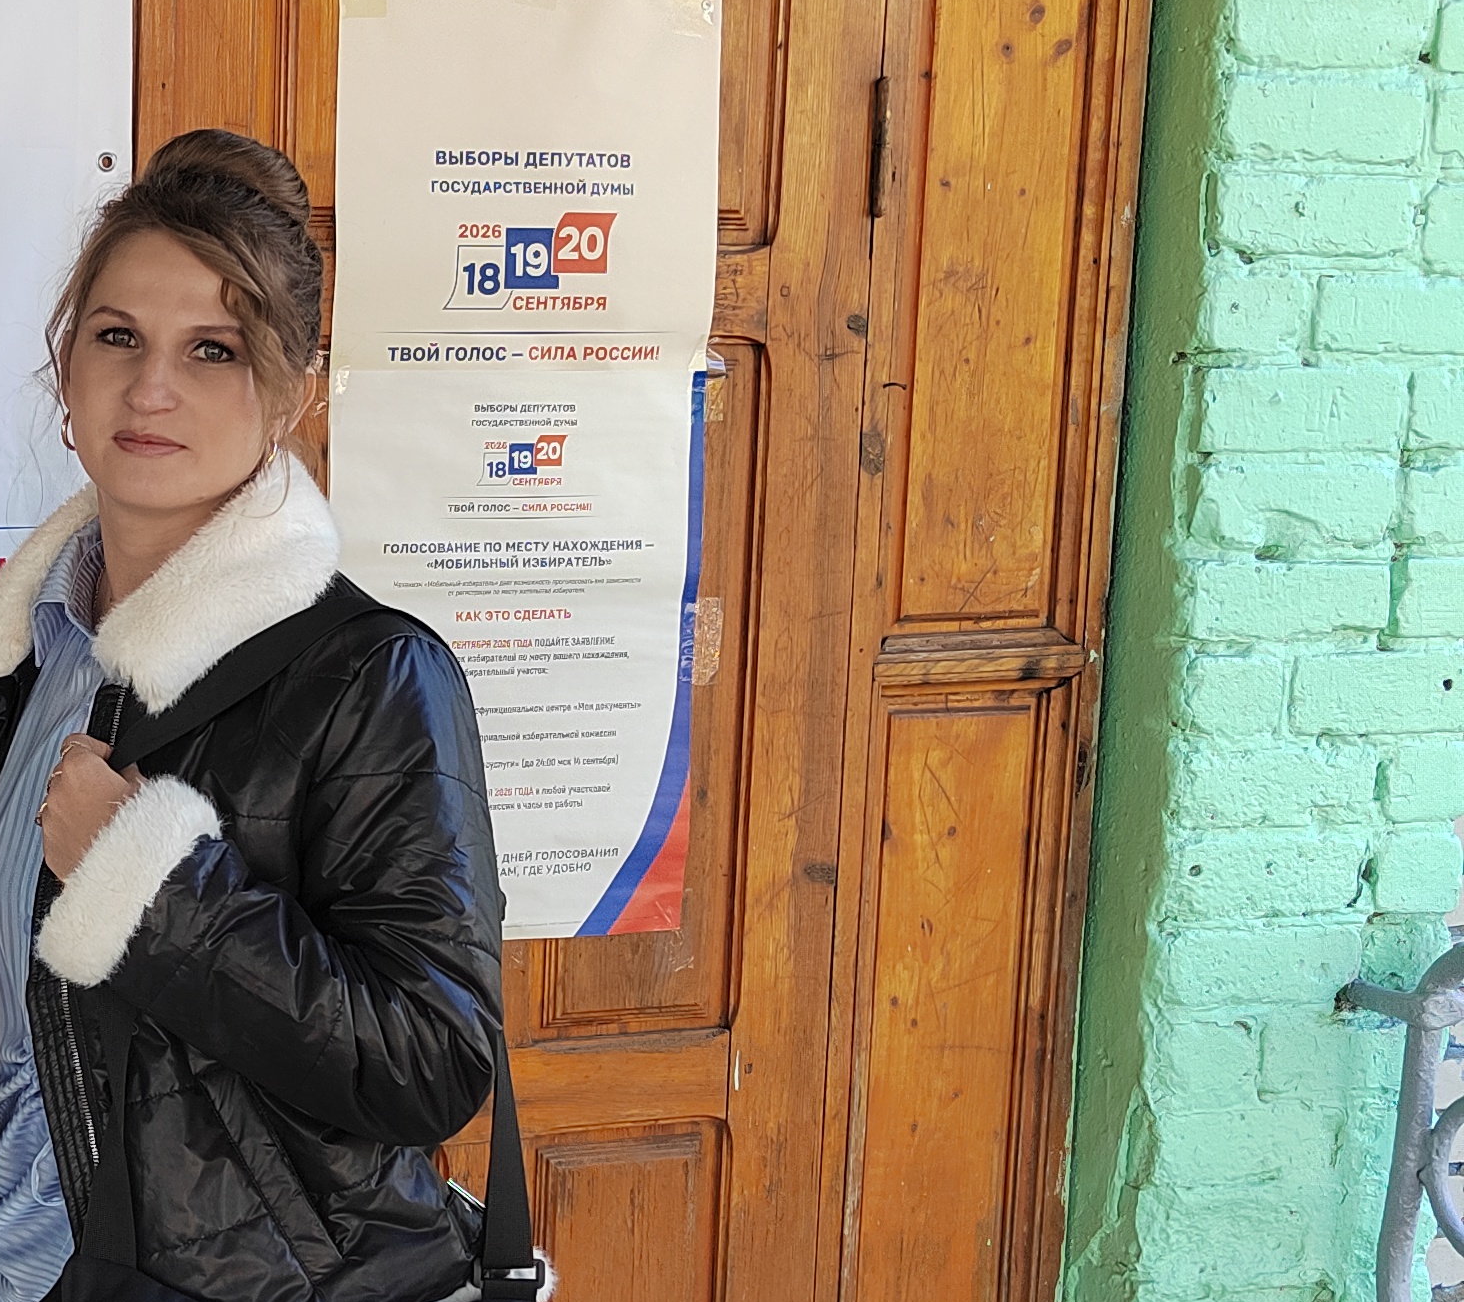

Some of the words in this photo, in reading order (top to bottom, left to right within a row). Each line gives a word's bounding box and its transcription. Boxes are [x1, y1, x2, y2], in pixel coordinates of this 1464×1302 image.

[435, 150, 519, 167] ВЫБОРЫ
[524, 152, 631, 169] ДЕПУТАТОВ
[431, 179, 586, 196] ГОСУДАРСТВЕННОЙ
[590, 182, 635, 198] ДУМЫ
[458, 224, 502, 239] 2026
[462, 262, 501, 296] 18
[510, 242, 549, 277] 19
[557, 226, 605, 261] 20
[512, 296, 607, 311] СЕНТЯБРЯ
[387, 342, 440, 362] ТВОЙ
[445, 346, 507, 362] ГОЛОС
[528, 345, 577, 362] СИЛА
[582, 345, 660, 362] РОССИИ!
[474, 403, 518, 413] ВЫБОРЫ
[520, 403, 576, 414] ДЕПУТАТОВ
[471, 417, 551, 428] ГОСУДАРСТВЕННОЙ
[553, 419, 578, 428] ДУМЫ
[486, 461, 506, 479] 18
[511, 450, 532, 469] 19
[536, 441, 561, 460] 20
[512, 477, 562, 486] СЕНТЯБРЯ
[448, 501, 475, 513] ТВОЙ
[477, 503, 511, 512] ГОЛОС
[521, 503, 548, 512] СИЛА
[383, 541, 480, 555] ГОЛОСОВАНИЕ
[483, 542, 502, 553] ПО
[505, 541, 550, 554] МЕСТУ
[552, 539, 643, 553] НАХОЖДЕНИЯ
[427, 555, 519, 570] «МОБИЛЬНЫЙ
[522, 556, 613, 569] ИЗБИРАТЕЛЬ»
[456, 610, 482, 622] КАК
[485, 609, 511, 622] ЭТО
[514, 608, 572, 623] СДЕЛАТЬ
[535, 636, 570, 648] ПОДАЙТЕ
[464, 667, 515, 678] бирательный
[501, 850, 532, 864] ДНЕЙ
[534, 847, 619, 861] ГОЛОСОВАНИЯ
[522, 865, 543, 876] ГДЕ
[546, 861, 592, 875] УДОБНО
